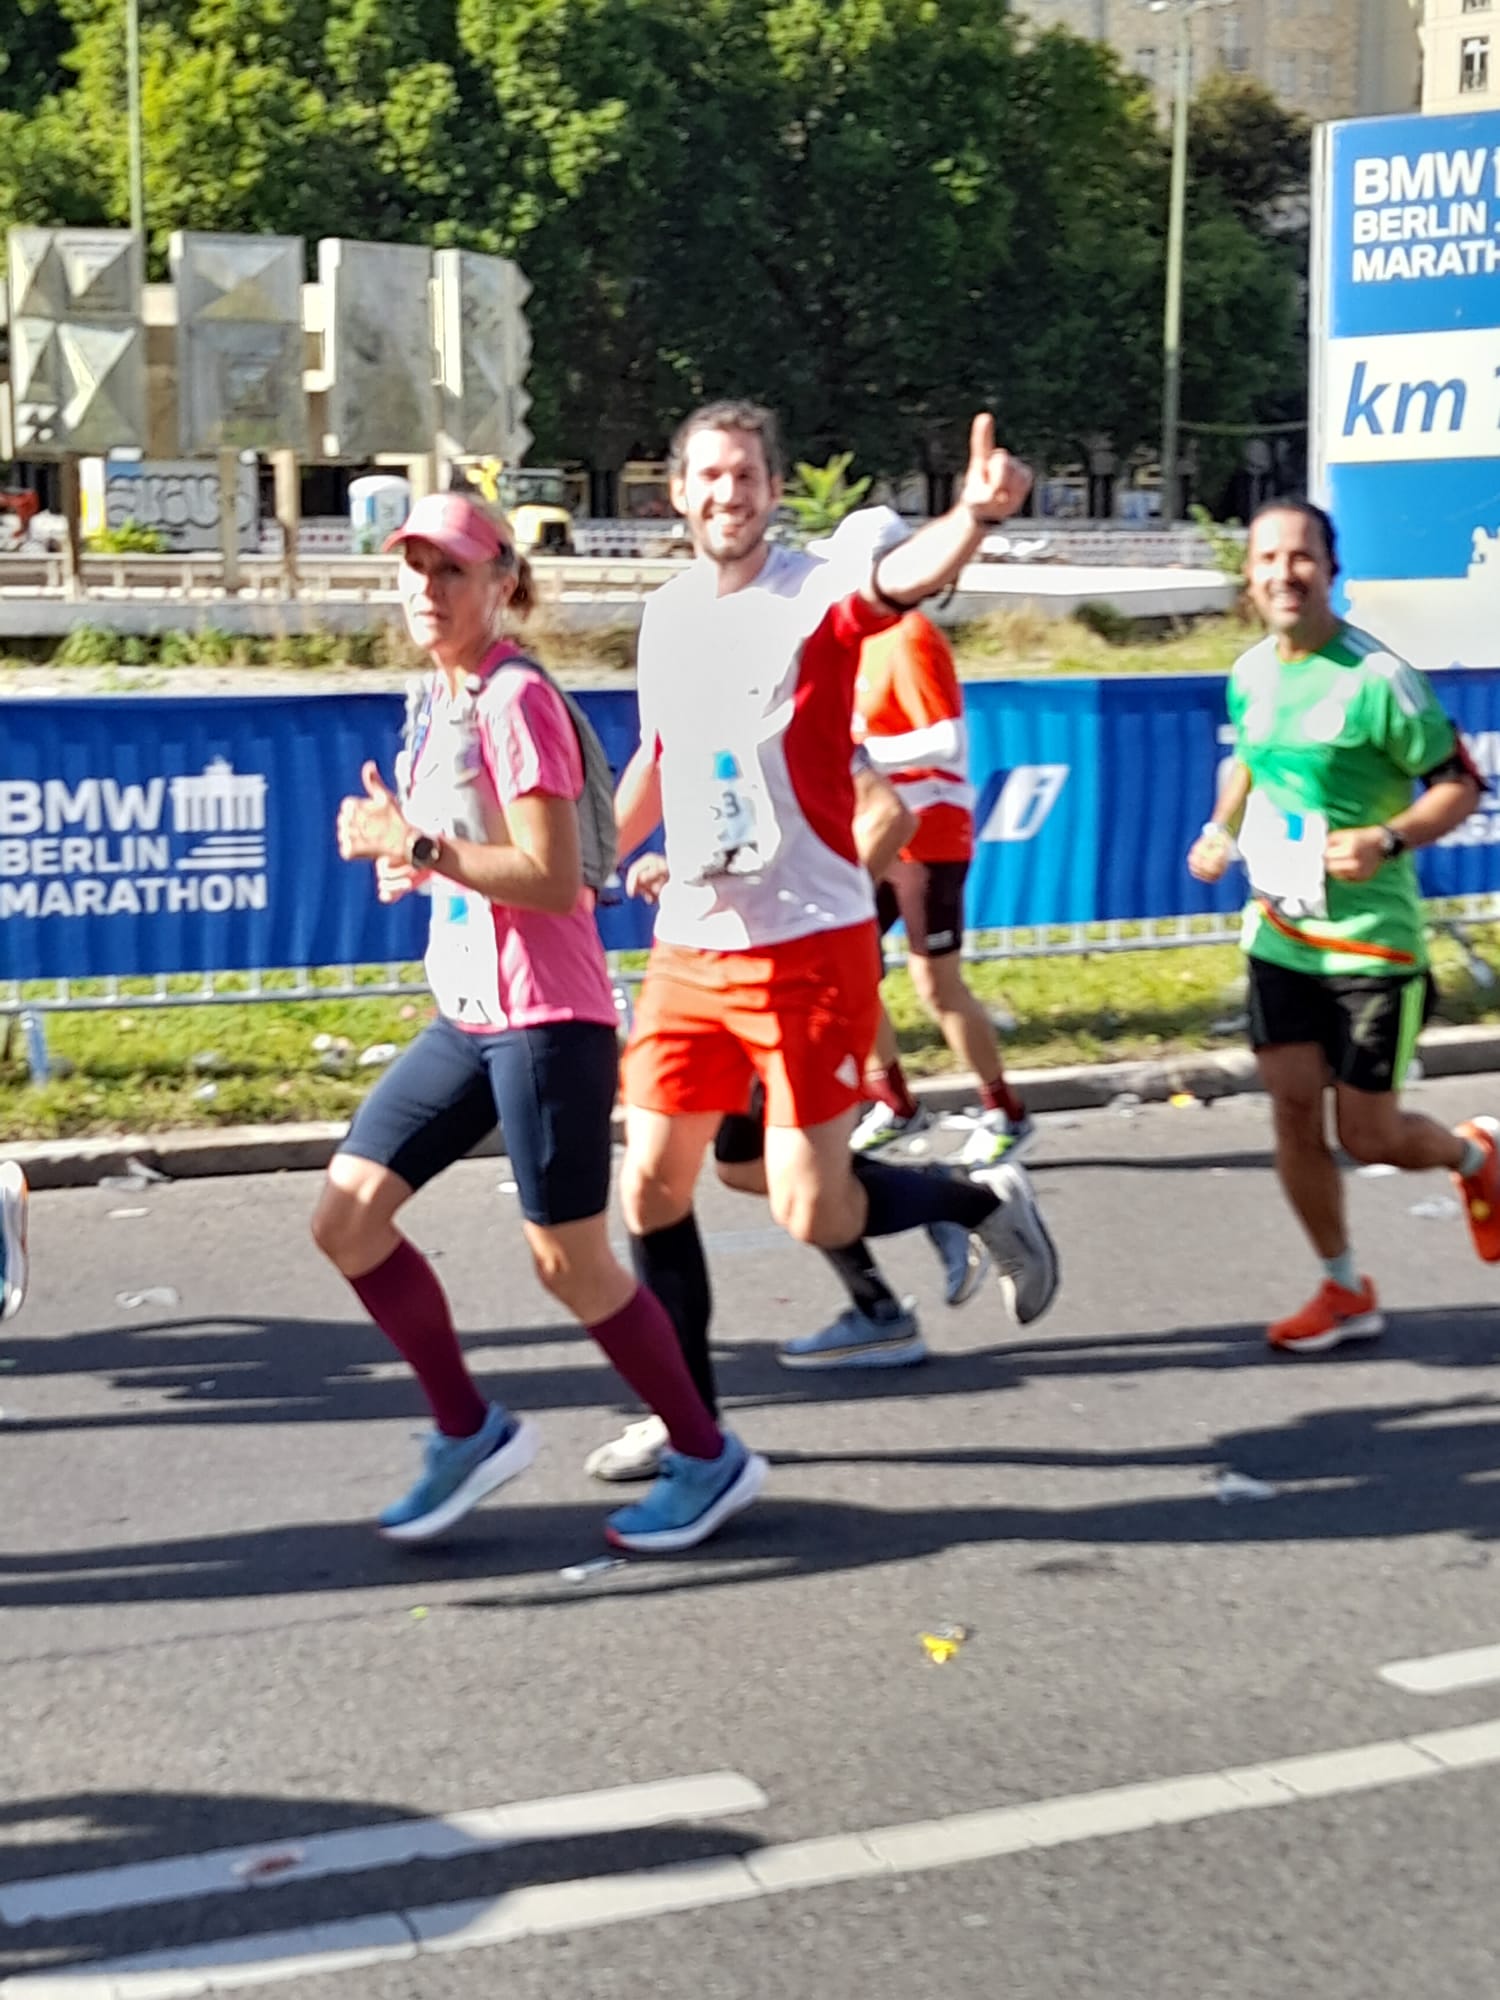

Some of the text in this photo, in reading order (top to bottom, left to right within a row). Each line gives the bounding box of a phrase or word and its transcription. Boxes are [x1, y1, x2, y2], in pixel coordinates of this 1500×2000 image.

[1353, 147, 1487, 206] BMW
[1353, 200, 1487, 244] BERLIN
[1343, 361, 1466, 435] km
[0, 778, 165, 834] BMW
[0, 835, 169, 876] BERLIN
[0, 874, 267, 917] MARATHON
